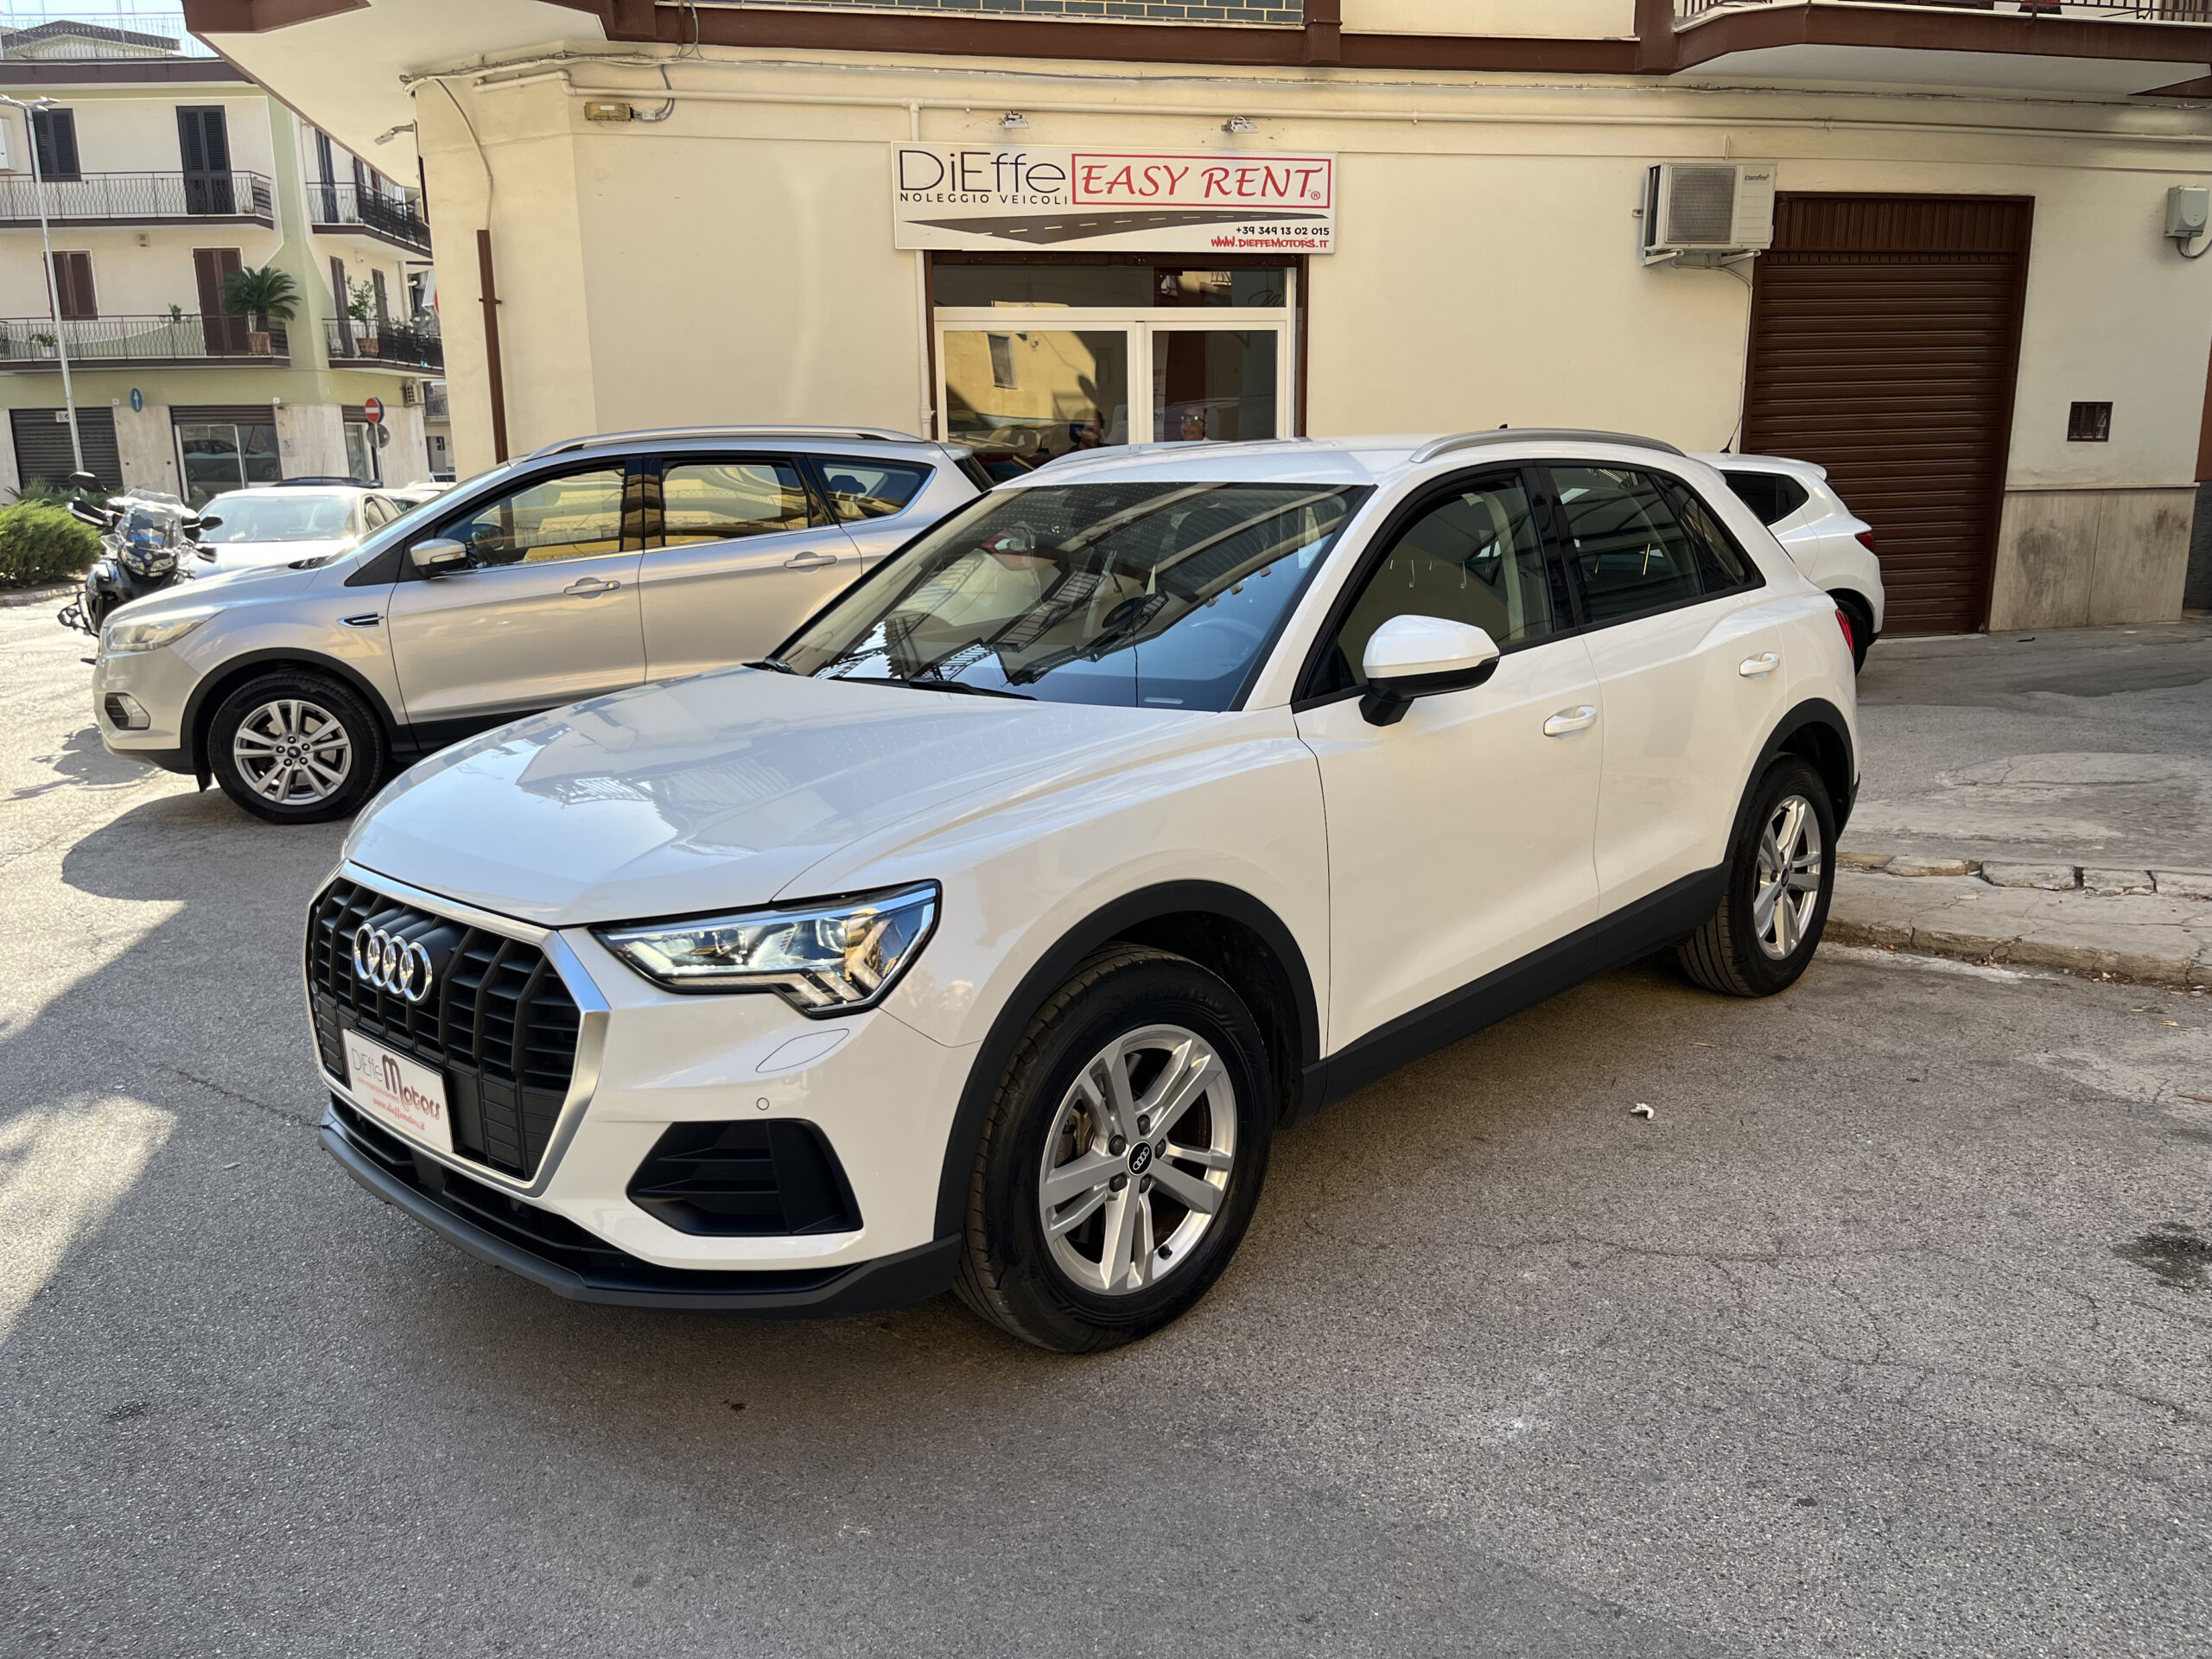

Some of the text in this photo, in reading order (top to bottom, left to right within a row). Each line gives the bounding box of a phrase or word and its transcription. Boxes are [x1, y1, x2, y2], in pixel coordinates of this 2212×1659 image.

[899, 149, 1066, 194] DiEffe
[1080, 164, 1189, 197] EASY
[899, 193, 1067, 205] NOLEGGIO VEICOLI
[1236, 226, 1255, 235] +39
[1258, 226, 1278, 235] 349
[1294, 227, 1308, 236] 02
[1311, 227, 1330, 236] 015
[382, 1054, 441, 1121] Motors
